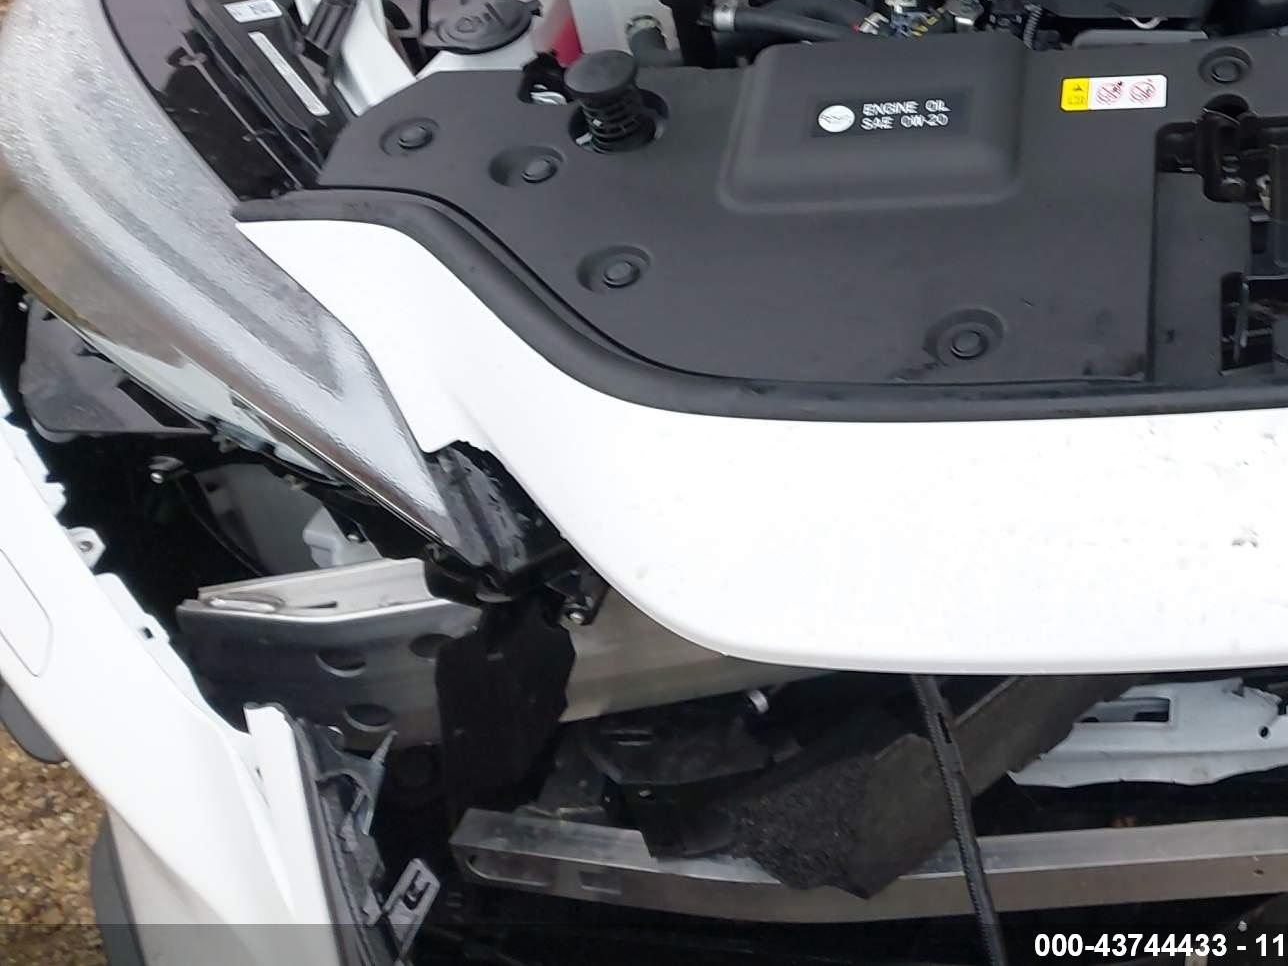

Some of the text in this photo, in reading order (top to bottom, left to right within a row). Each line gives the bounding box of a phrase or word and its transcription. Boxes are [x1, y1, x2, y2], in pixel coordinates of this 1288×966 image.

[862, 99, 951, 116] ENGINE OIL
[861, 116, 894, 131] SAE
[900, 113, 949, 128] 0W-20
